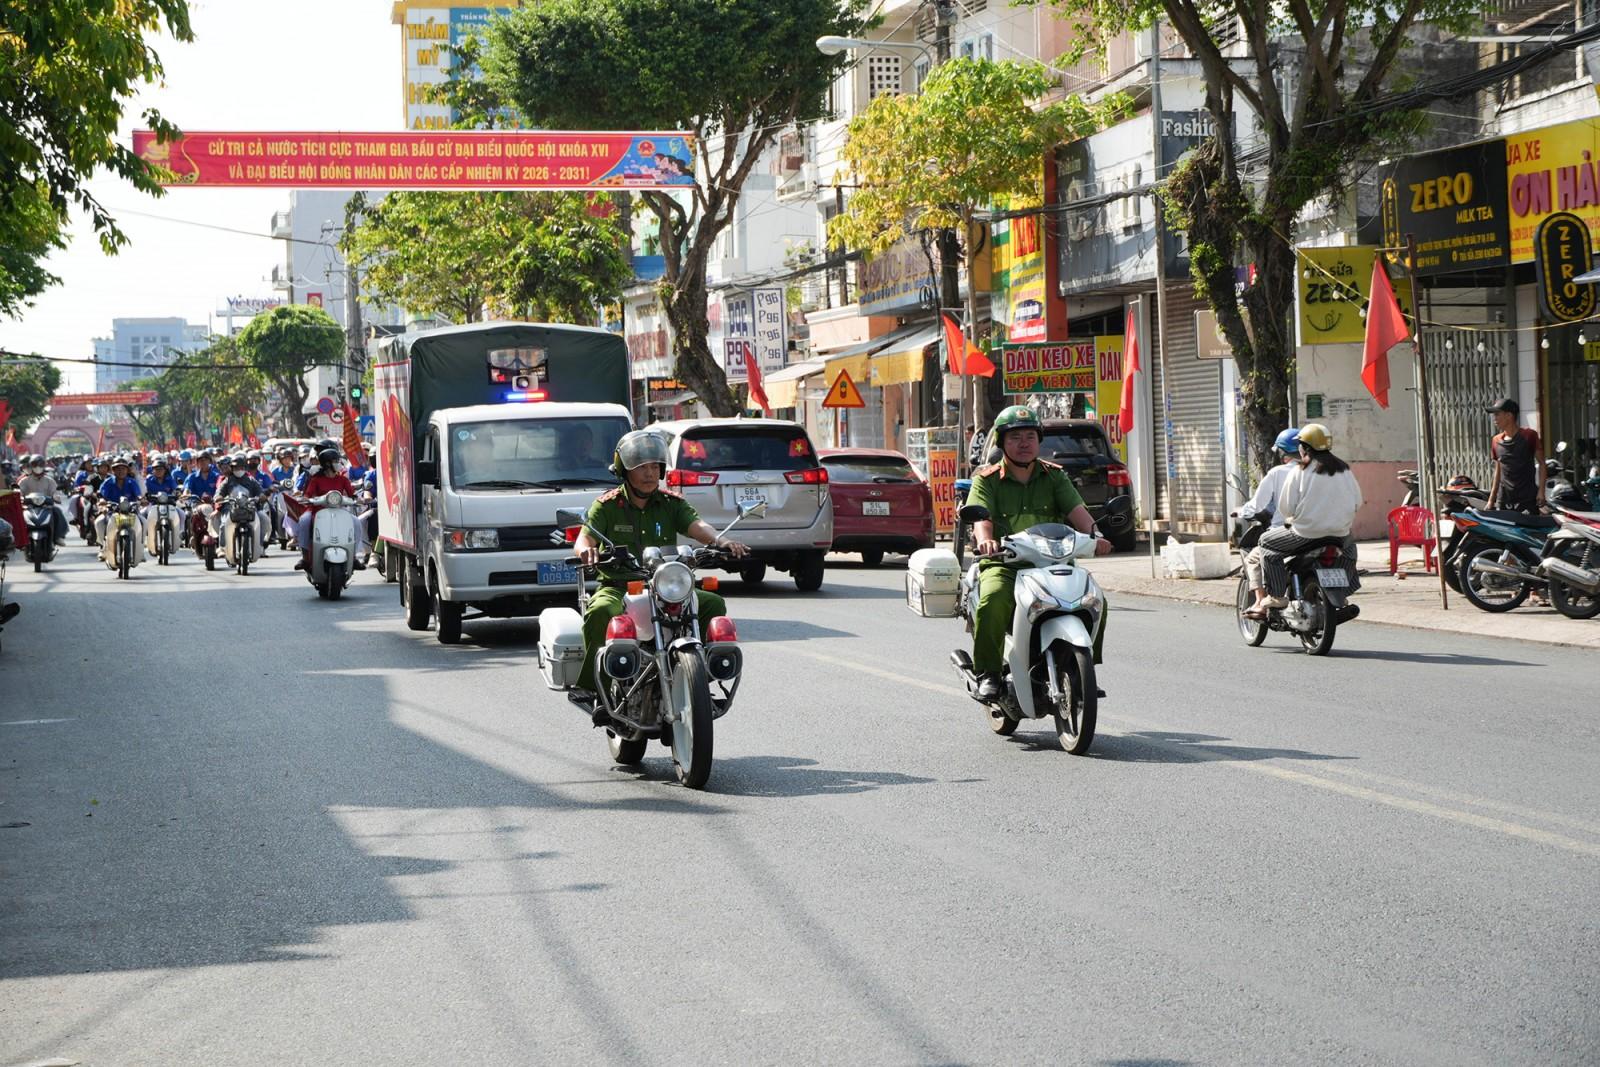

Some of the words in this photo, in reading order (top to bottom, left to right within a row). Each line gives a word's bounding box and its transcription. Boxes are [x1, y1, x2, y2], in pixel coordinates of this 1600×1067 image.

[1161, 118, 1216, 137] Fashio
[208, 138, 224, 156] CỬ
[227, 142, 244, 156] TRI
[248, 138, 263, 156] CẢ
[267, 139, 297, 156] NƯỚC
[300, 139, 326, 156] TÍCH
[329, 142, 351, 159] CỰC
[354, 143, 386, 157] THAM
[390, 143, 408, 157] GIA
[437, 139, 453, 157] CỬ
[455, 143, 474, 160] ĐẠI
[477, 138, 502, 157] BIỂU
[505, 139, 534, 159] QUỐC
[538, 141, 556, 160] HỘI
[559, 141, 588, 157] KHÓA
[591, 143, 609, 157] XVI
[1525, 139, 1541, 161] XE
[229, 162, 244, 179] VÀ
[247, 165, 266, 182] ĐẠI
[269, 160, 295, 179] BIỂU
[298, 162, 317, 182] HỘI
[354, 163, 386, 180] NHÂN
[389, 163, 412, 180] DÂN
[415, 163, 438, 180] CÁC
[441, 161, 463, 180] CẤP
[466, 163, 502, 183] NHIỆM
[505, 163, 519, 180] KỲ
[522, 166, 549, 180] 2026
[560, 166, 590, 180] 2031!
[1409, 172, 1473, 213] ZERO
[1456, 207, 1476, 224] MILK
[1476, 205, 1493, 221] TEA
[1558, 226, 1577, 298] ZERO
[1305, 281, 1361, 304] ZERO
[1041, 346, 1072, 371] KEO
[1076, 344, 1096, 368] XE
[1076, 374, 1095, 388] XE
[939, 508, 953, 526] XE
